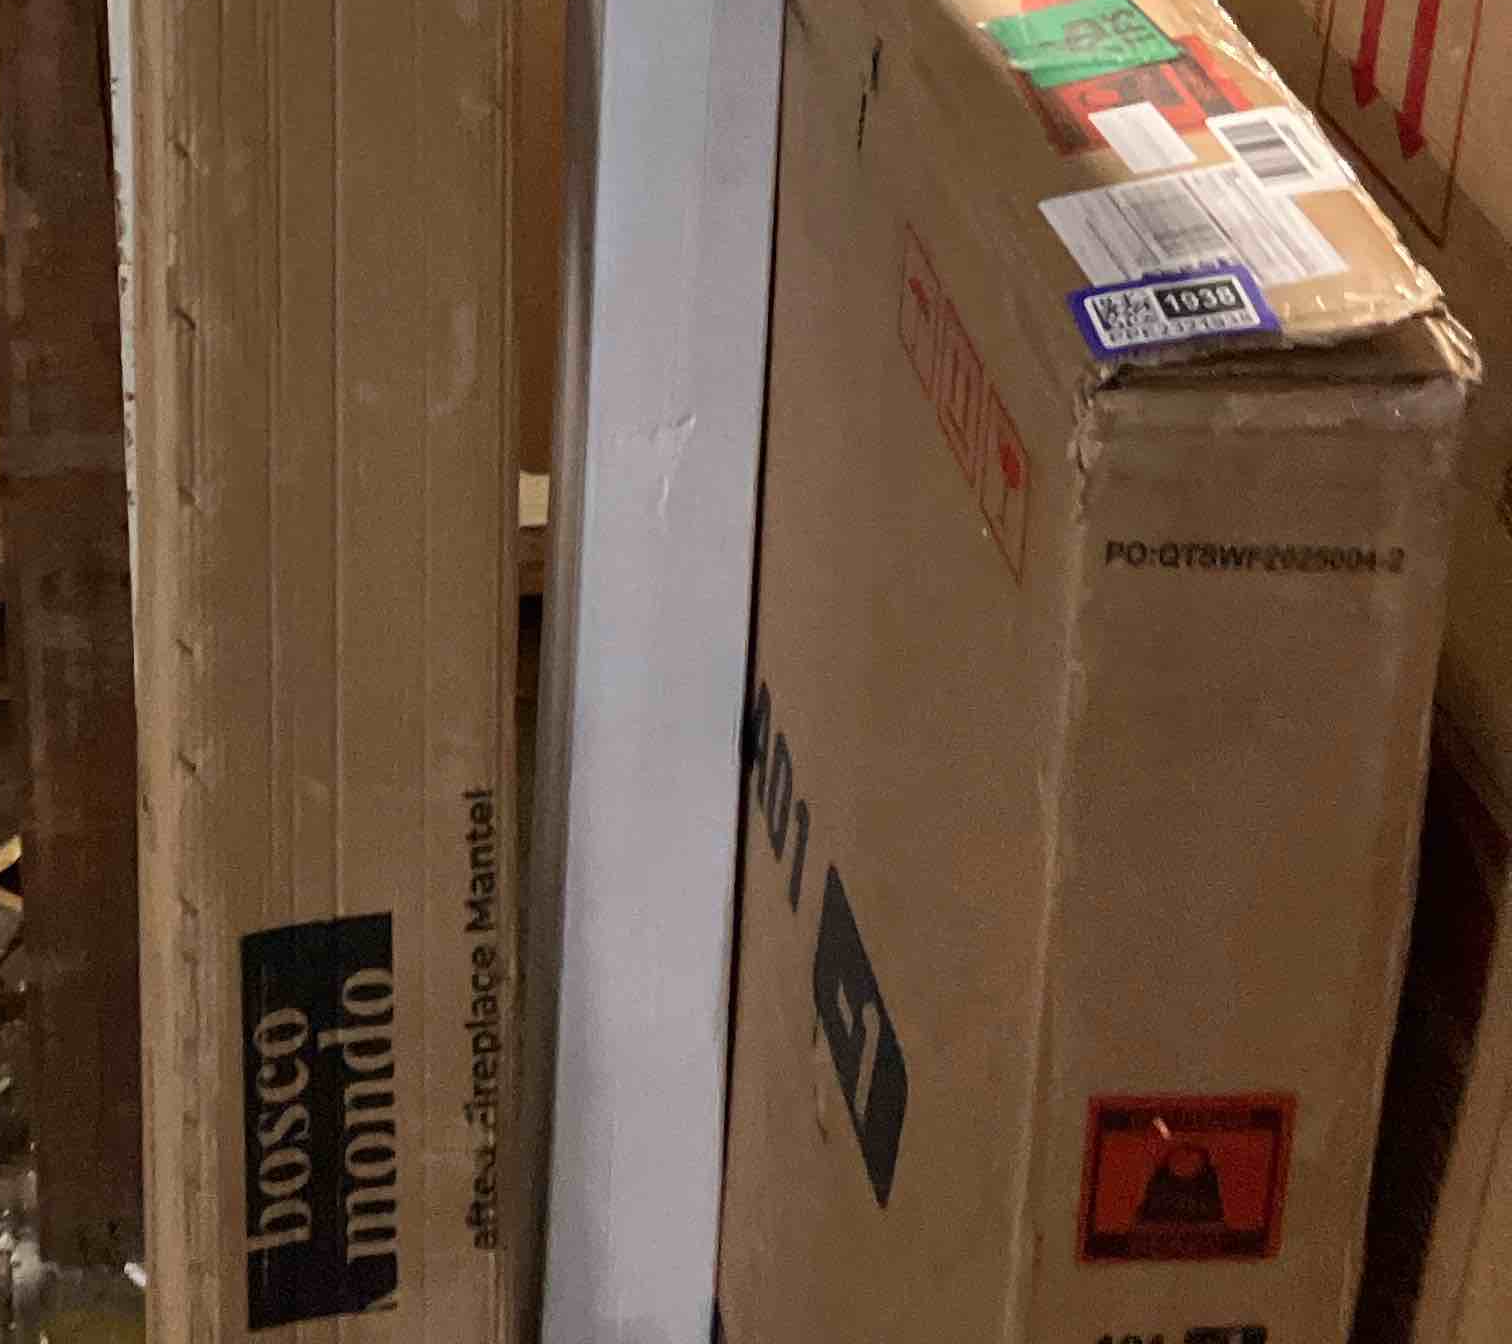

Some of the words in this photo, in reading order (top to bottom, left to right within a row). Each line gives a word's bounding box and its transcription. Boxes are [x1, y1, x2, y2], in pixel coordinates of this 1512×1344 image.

[1163, 284, 1237, 314] 1938
[465, 787, 496, 934] Mantel
[247, 1006, 313, 1253] bosco
[317, 966, 400, 1265] mondo
